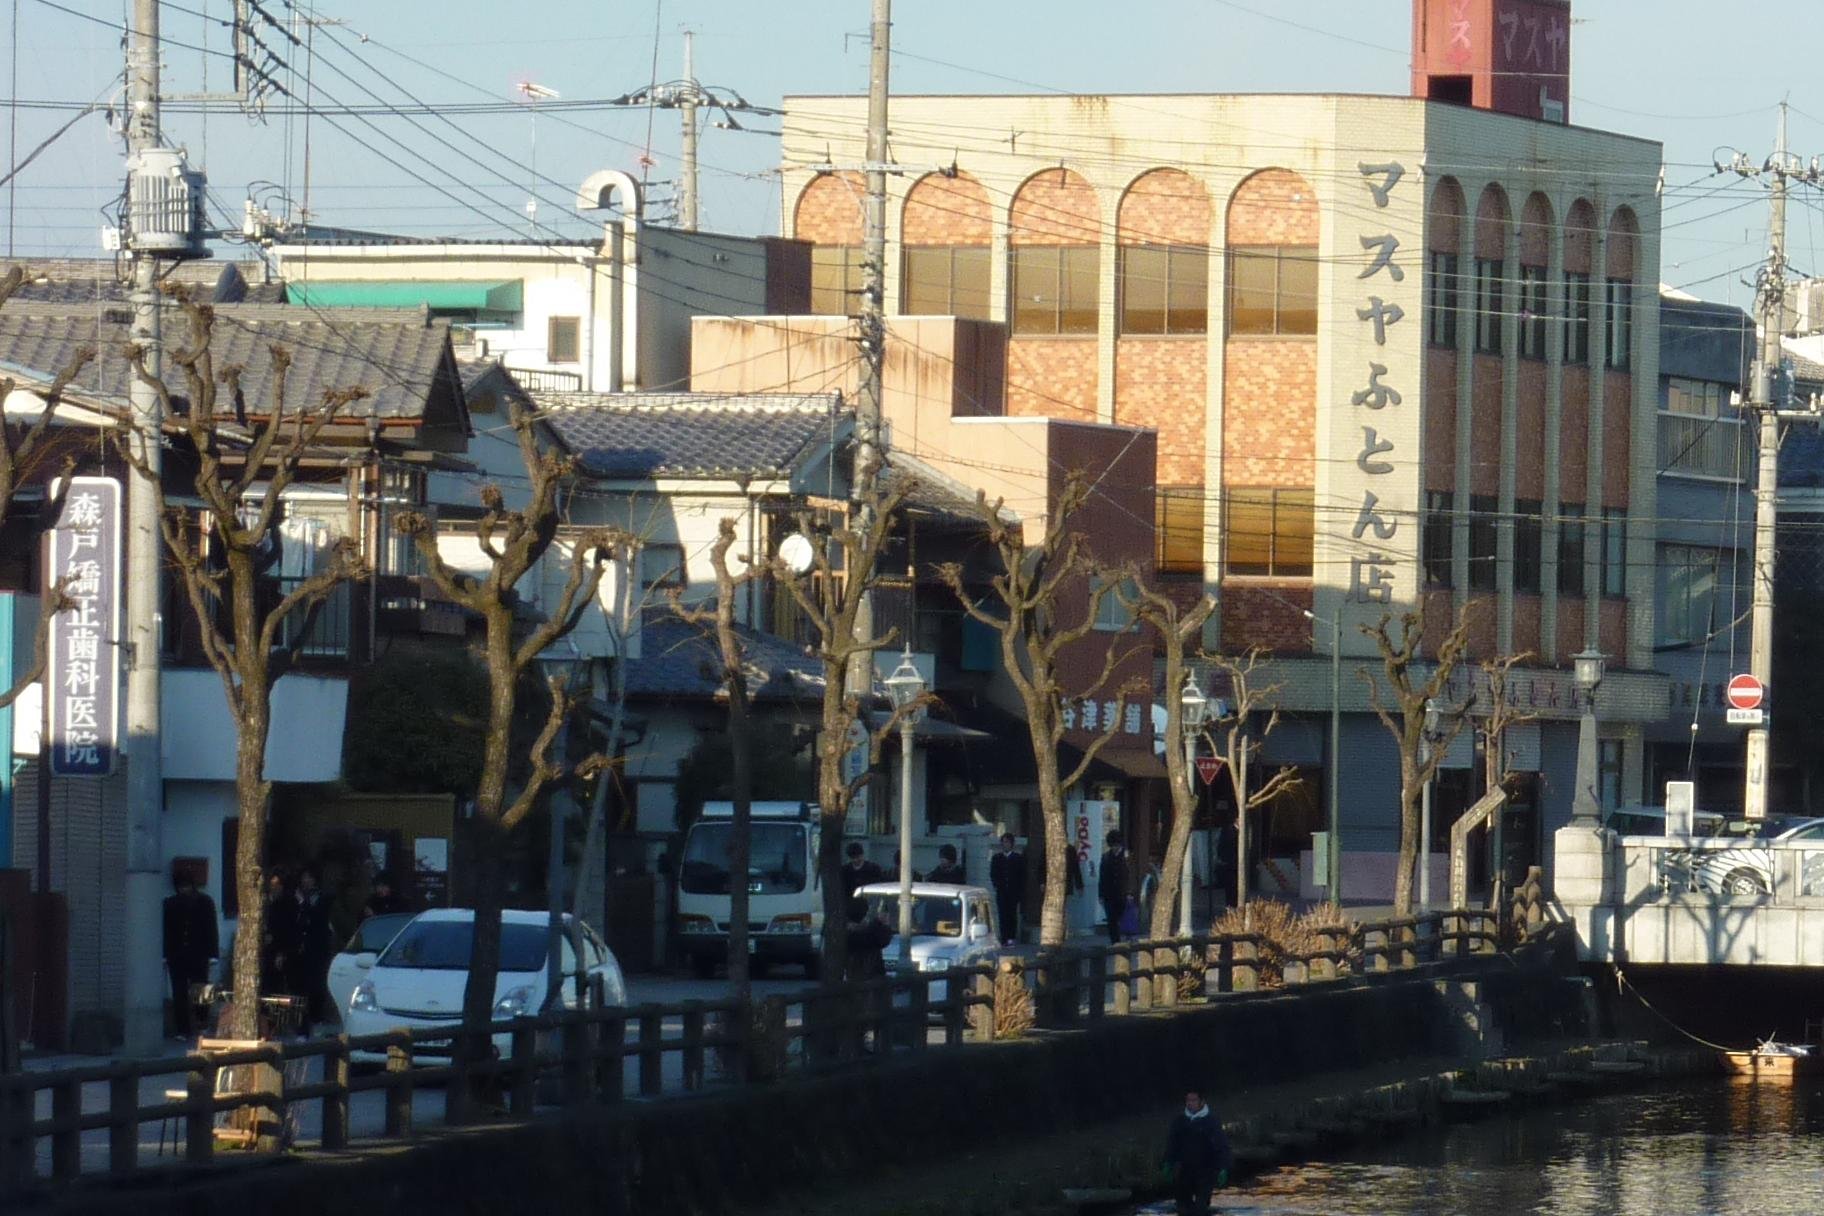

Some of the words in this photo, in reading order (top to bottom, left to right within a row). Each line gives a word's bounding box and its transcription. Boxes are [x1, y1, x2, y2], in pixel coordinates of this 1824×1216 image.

[1499, 10, 1566, 71] マスヤ
[1347, 160, 1406, 605] マスヤふとん店
[64, 492, 103, 765] 森戸矯正歯科医院
